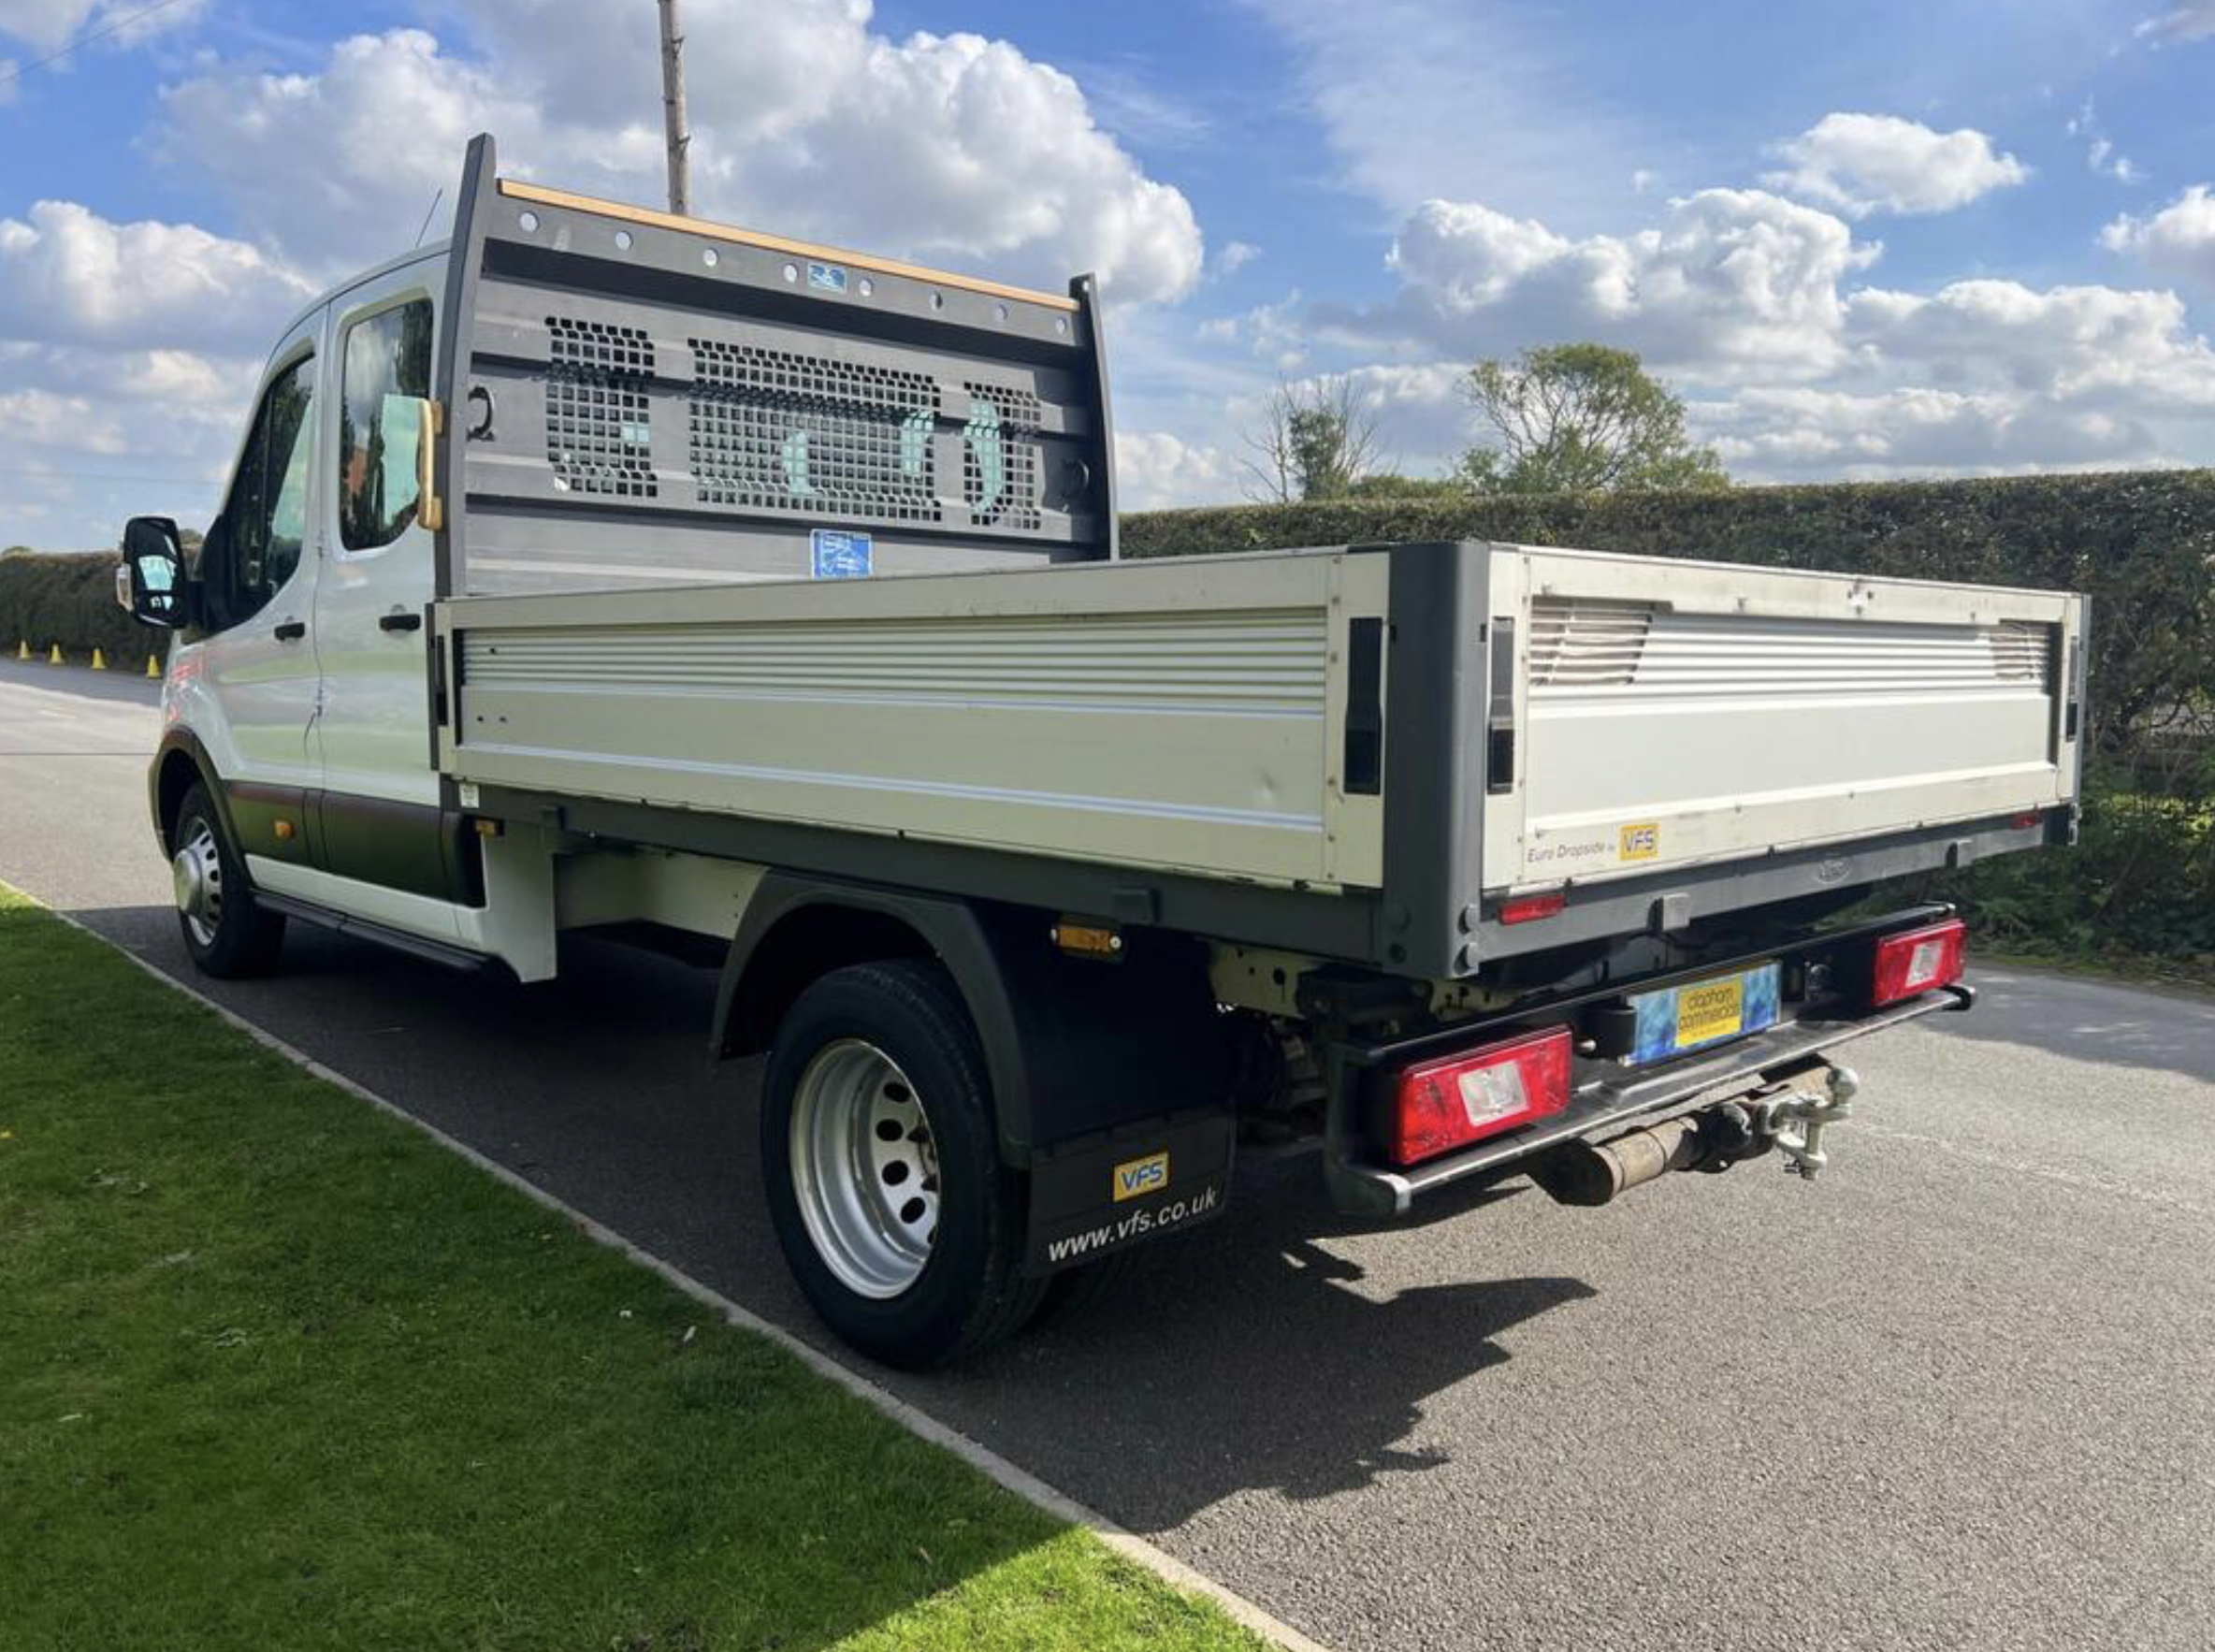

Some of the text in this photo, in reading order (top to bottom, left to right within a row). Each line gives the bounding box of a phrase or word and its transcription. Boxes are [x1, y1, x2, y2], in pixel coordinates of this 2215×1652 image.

[1527, 848, 1555, 862] Euro
[1624, 830, 1655, 852] VFS
[1121, 1161, 1164, 1191] VFS
[1049, 1186, 1217, 1262] www.vfs.co.uk
